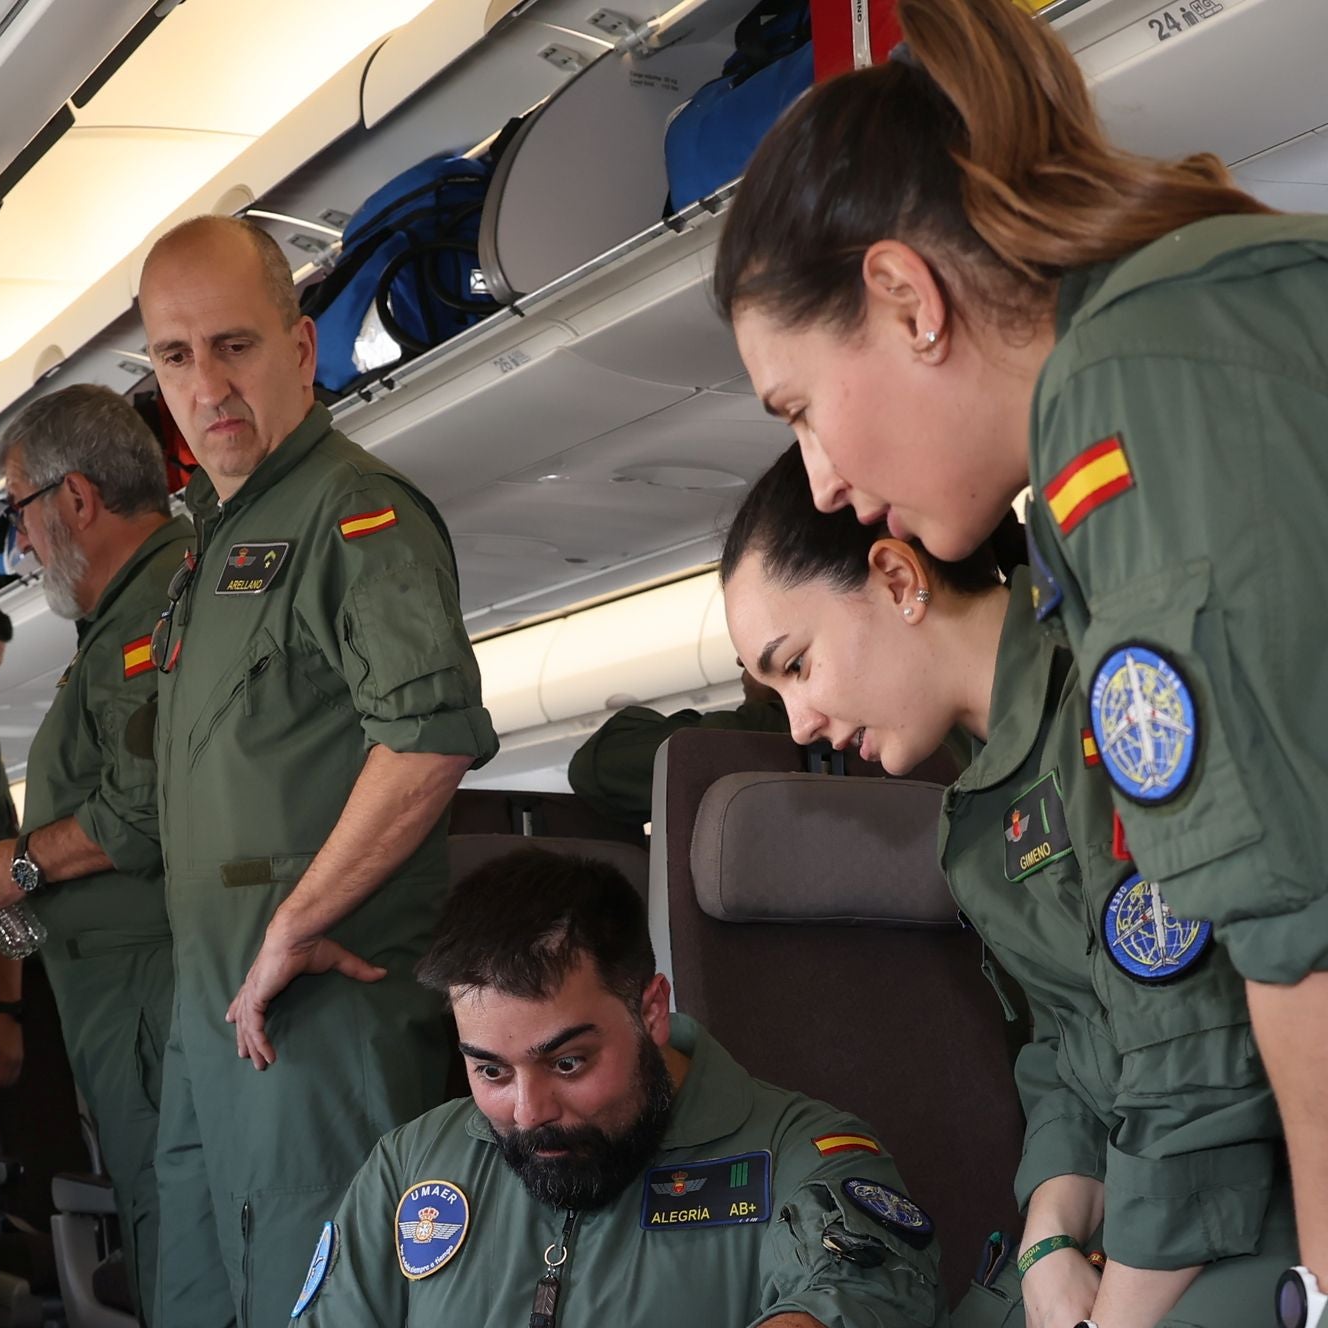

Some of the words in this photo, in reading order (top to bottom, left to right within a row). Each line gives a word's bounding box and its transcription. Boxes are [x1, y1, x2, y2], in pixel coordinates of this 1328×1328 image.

[1148, 11, 1183, 41] 24
[226, 579, 263, 591] ARELLANO
[1019, 842, 1052, 871] GIMENO
[1109, 886, 1128, 913] A330
[410, 1185, 458, 1205] UMAER
[651, 1204, 711, 1224] ALEGRÍA
[729, 1201, 757, 1217] AB+
[434, 1245, 454, 1265] tiempo
